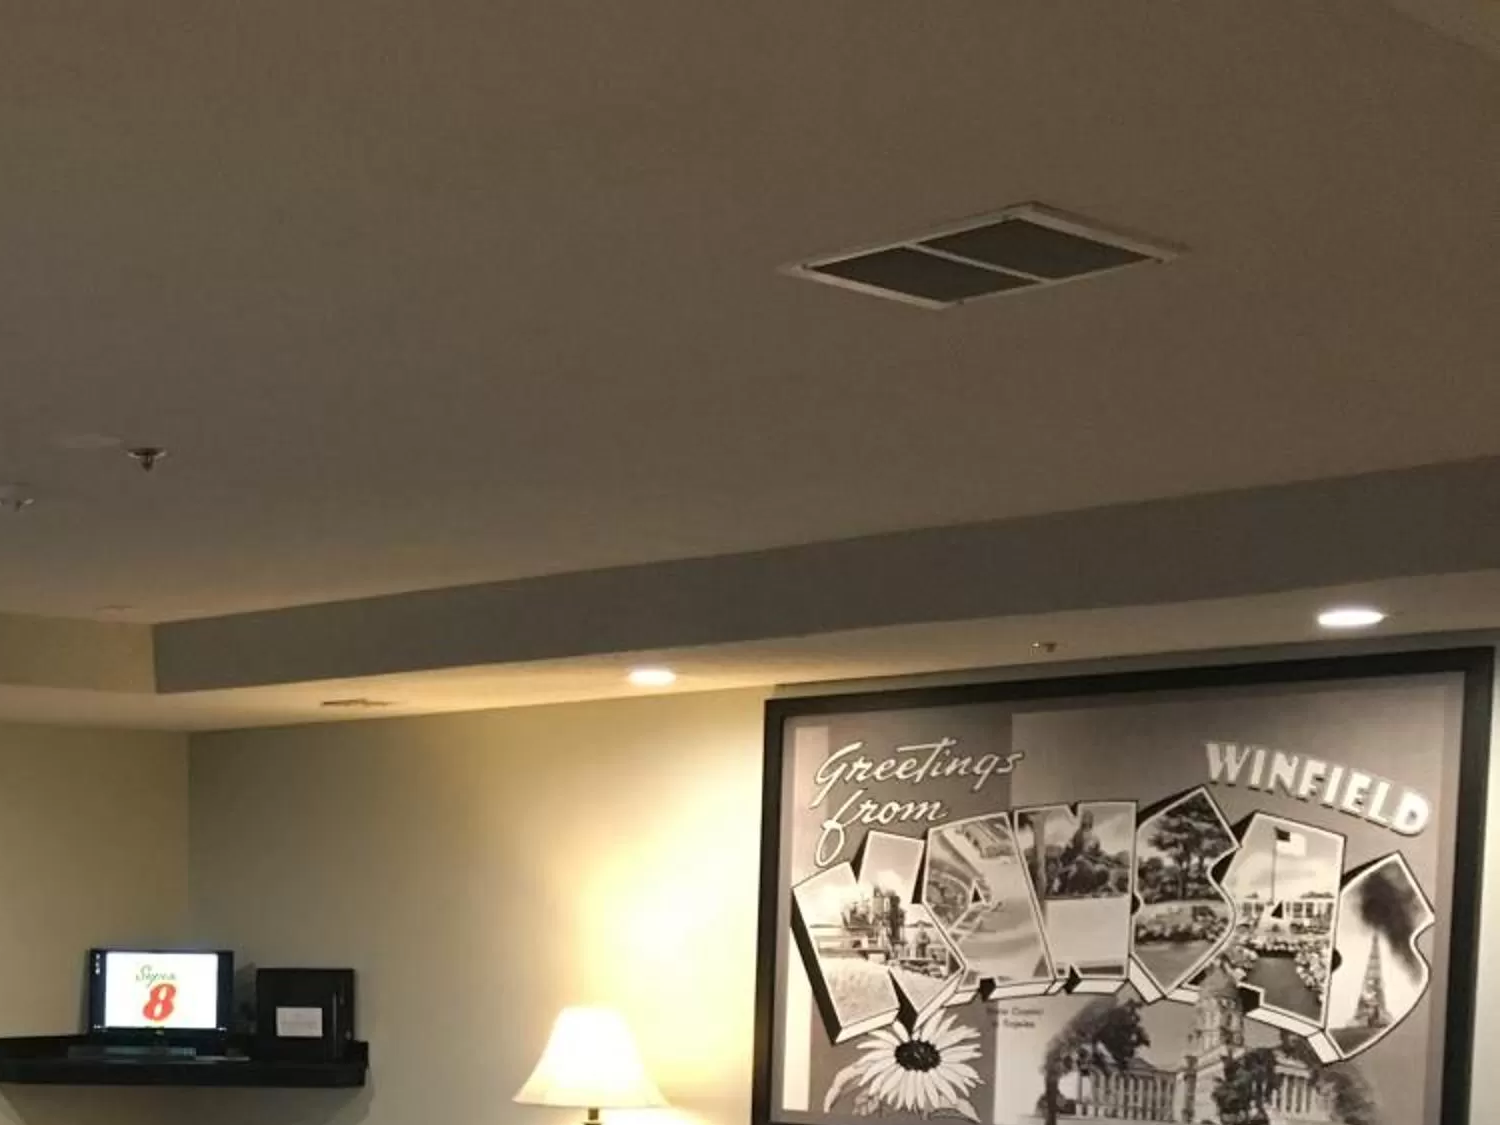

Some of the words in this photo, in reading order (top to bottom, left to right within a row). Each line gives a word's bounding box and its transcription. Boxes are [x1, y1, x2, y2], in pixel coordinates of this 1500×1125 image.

[809, 736, 1024, 810] Greetings
[1205, 741, 1430, 837] WINFIELD
[815, 788, 949, 867] from
[791, 786, 1435, 1064] KANSAS
[142, 983, 177, 1022] 8
